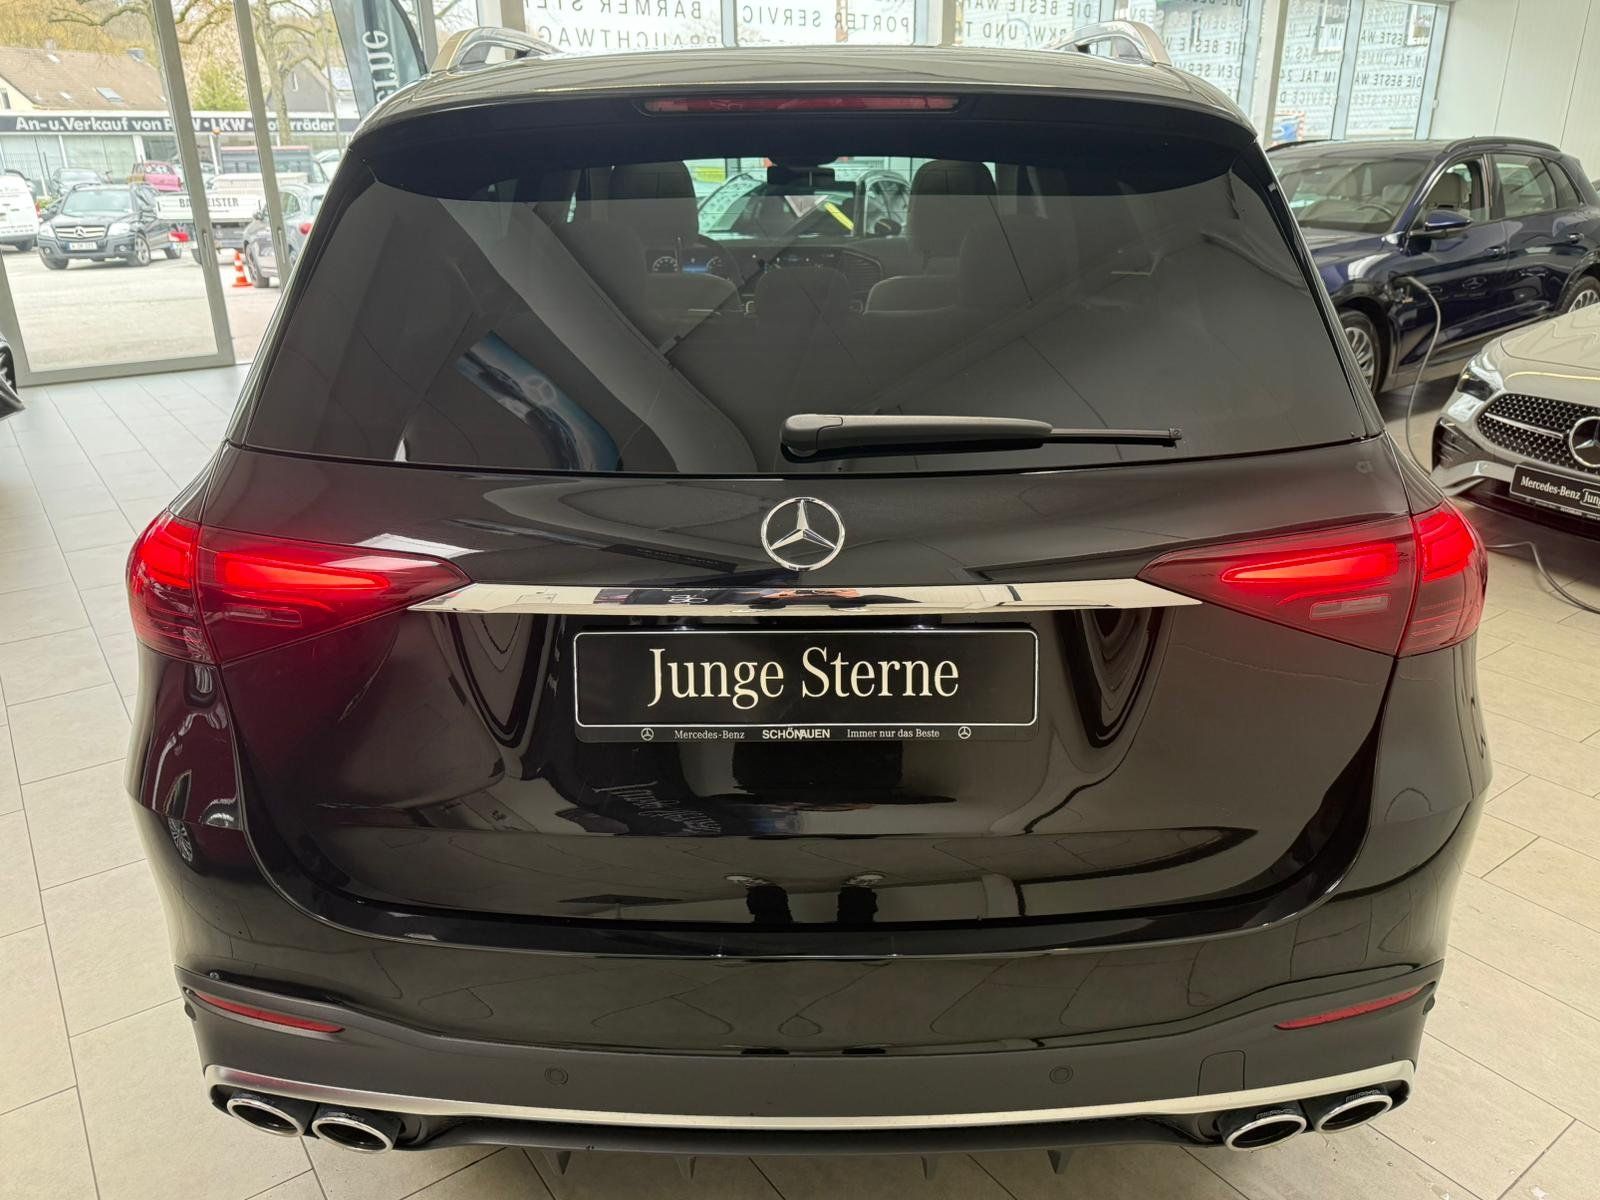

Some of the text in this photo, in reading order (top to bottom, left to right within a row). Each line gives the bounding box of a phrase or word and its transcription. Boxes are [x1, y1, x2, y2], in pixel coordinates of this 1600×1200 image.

[133, 118, 162, 131] von
[211, 117, 245, 131] LKW
[1520, 475, 1581, 500] Mercedes-Benz
[647, 646, 960, 710] Junge Sterne
[674, 729, 745, 740] Mercedes-Benz
[762, 727, 831, 740] SCHÖNAUEN
[847, 729, 878, 738] Immer
[897, 728, 914, 738] das
[915, 728, 940, 738] Beste
